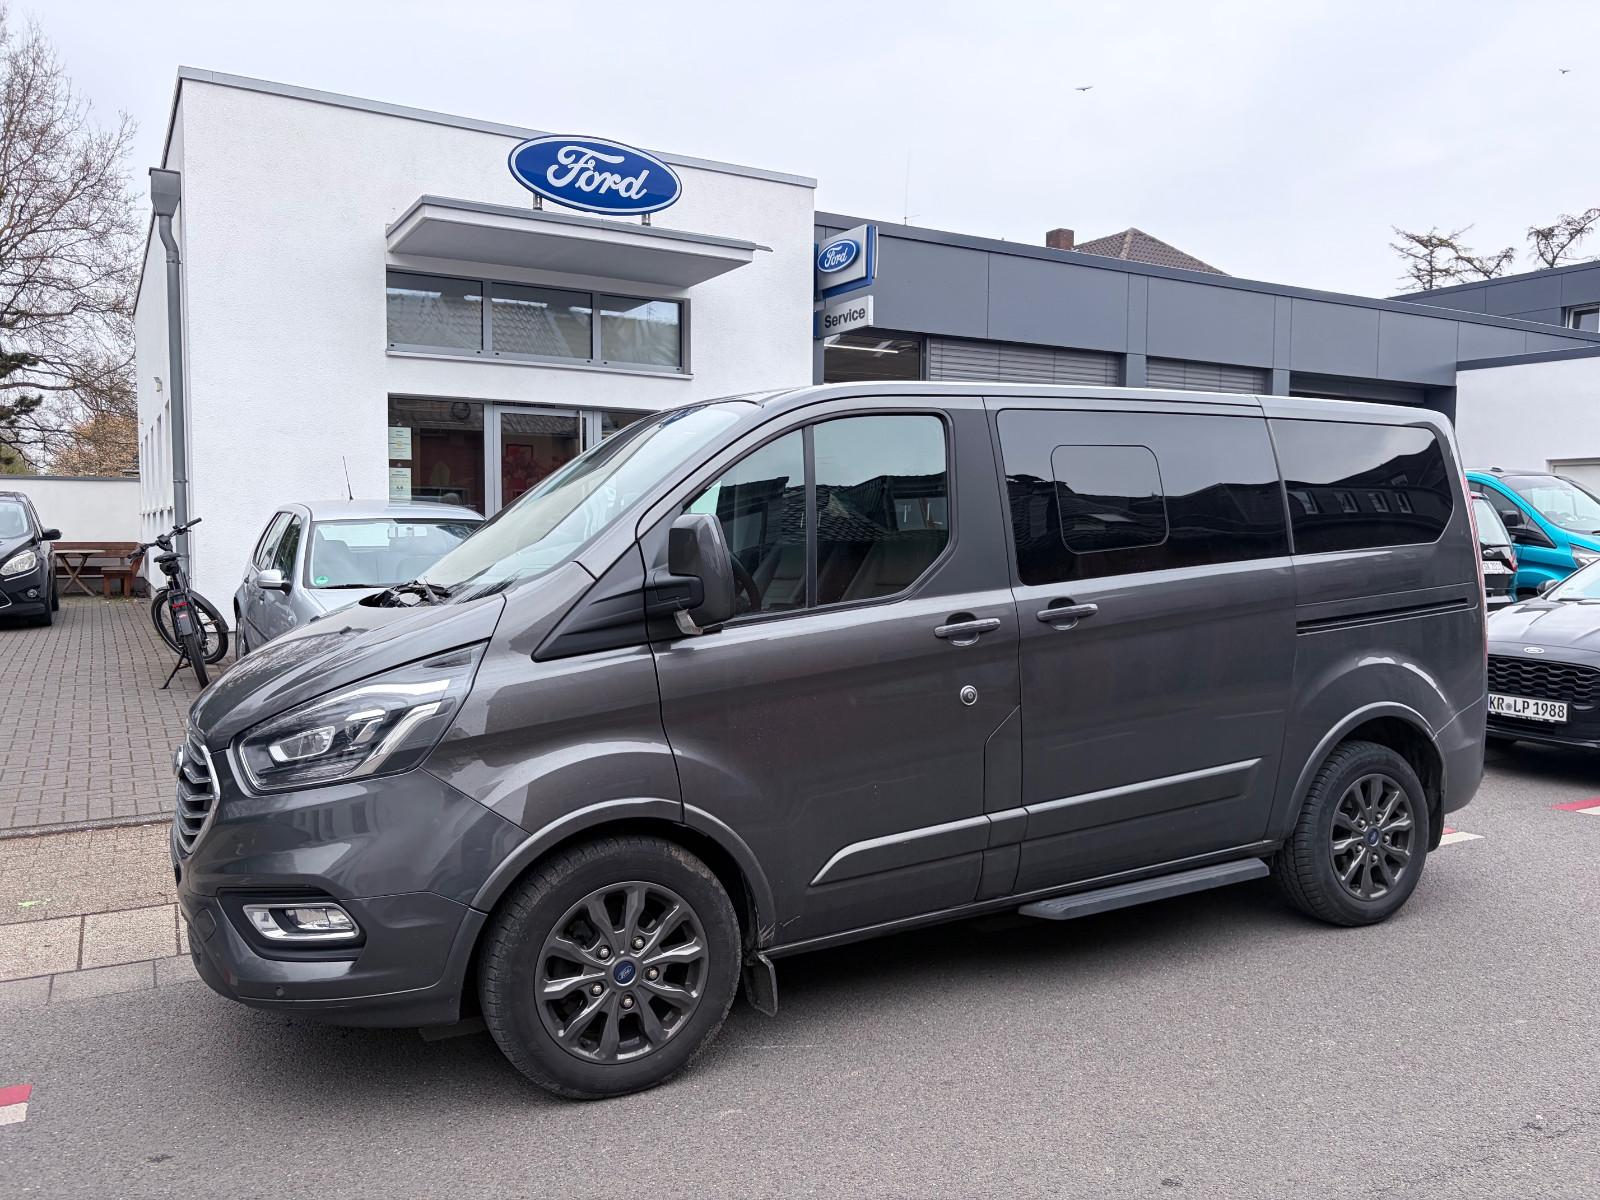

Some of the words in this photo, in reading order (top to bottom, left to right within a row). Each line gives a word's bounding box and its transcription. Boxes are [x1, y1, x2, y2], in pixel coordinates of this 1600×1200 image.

[546, 145, 650, 200] Ford
[824, 245, 848, 268] Ford
[824, 307, 866, 329] Service
[1489, 696, 1504, 711] KR
[1513, 699, 1530, 713] LP
[1532, 702, 1565, 718] 1988
